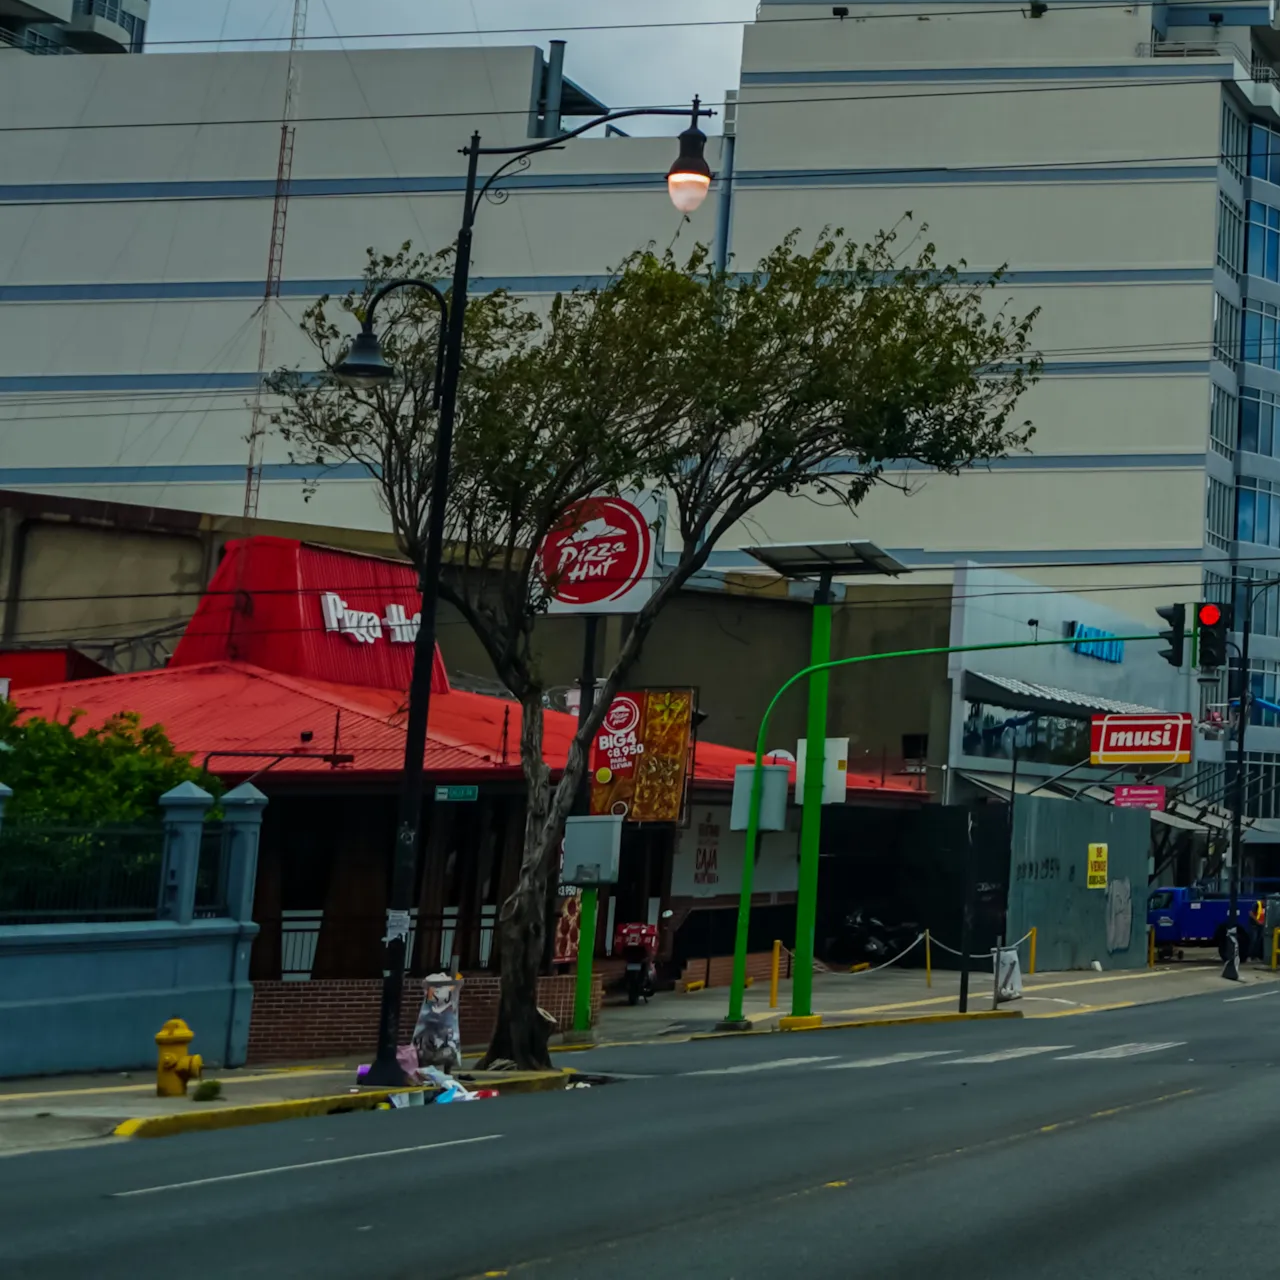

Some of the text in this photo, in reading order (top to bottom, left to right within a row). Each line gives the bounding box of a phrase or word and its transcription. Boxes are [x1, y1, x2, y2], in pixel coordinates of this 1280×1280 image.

[557, 541, 628, 575] Pizza
[568, 557, 619, 584] Hut
[321, 591, 383, 644] Pizza
[381, 603, 421, 643] Hu
[1109, 723, 1171, 747] musi
